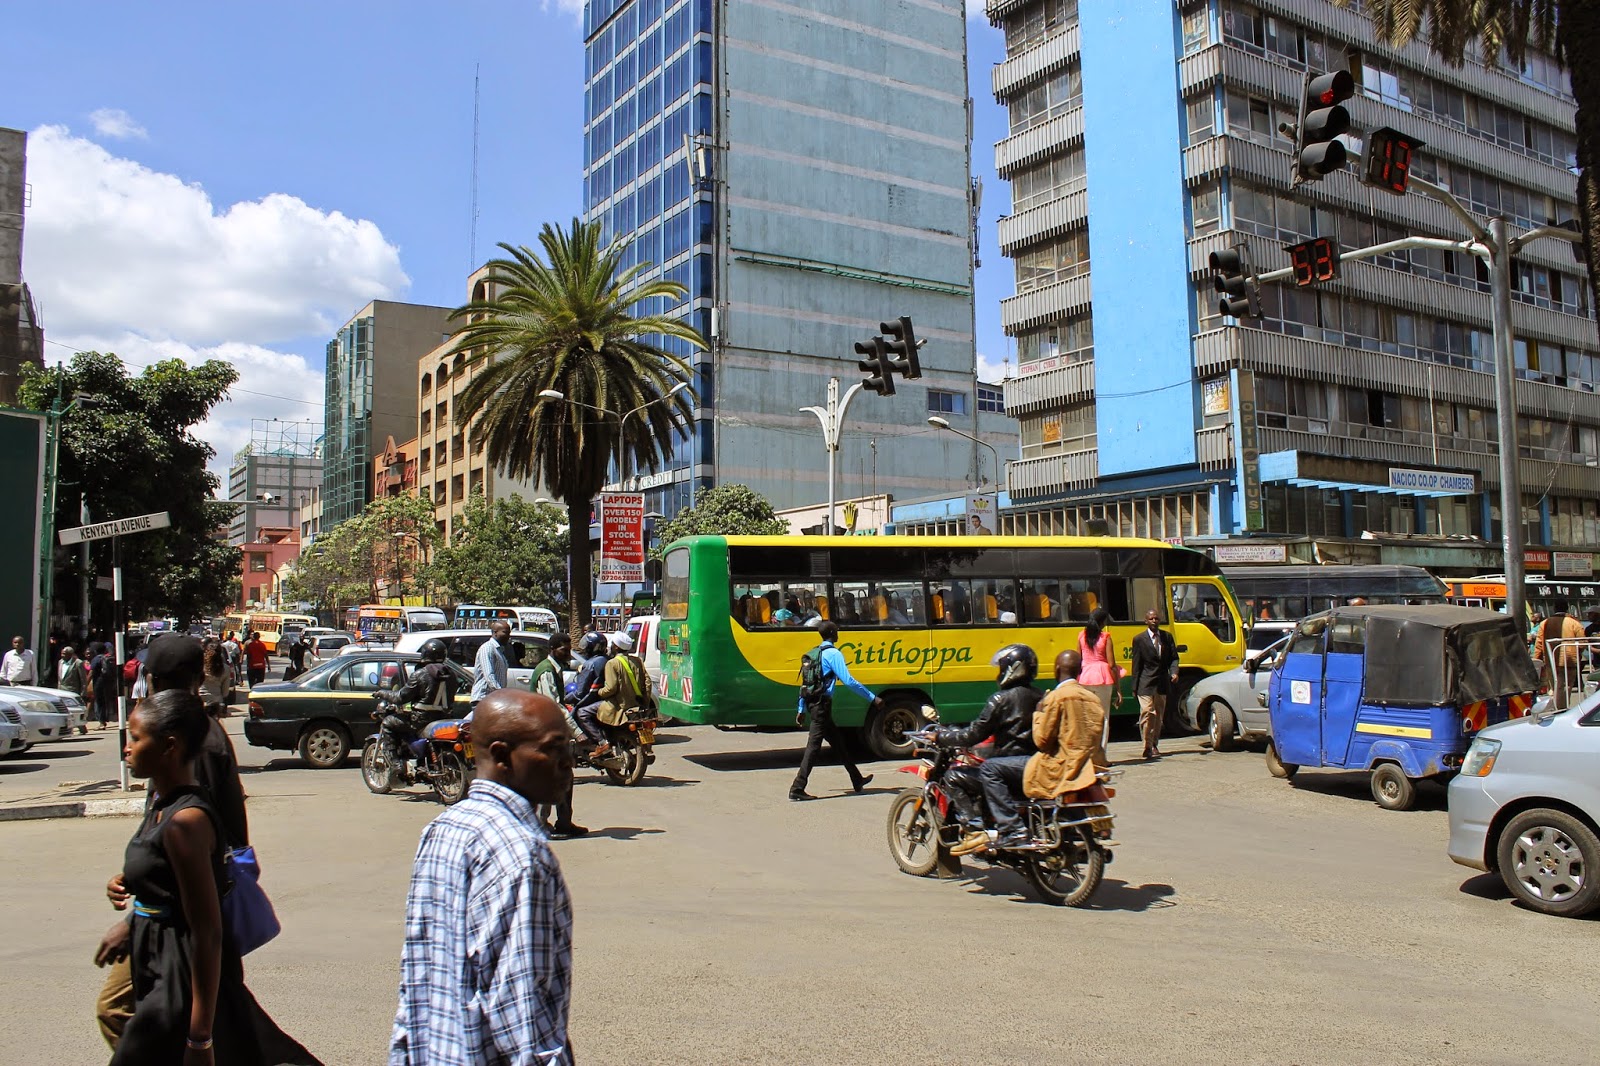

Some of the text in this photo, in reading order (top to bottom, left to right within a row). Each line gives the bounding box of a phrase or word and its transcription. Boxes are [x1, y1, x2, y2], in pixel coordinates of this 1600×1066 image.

[1384, 140, 1411, 192] 13
[1043, 359, 1056, 369] CYBER
[641, 472, 671, 488] CREDIT
[1246, 465, 1259, 510] PLUS
[1391, 472, 1417, 487] NACICO
[1440, 475, 1474, 491] CHAMBERS
[602, 495, 643, 504] LAPTOPS
[80, 517, 151, 540] KENYATTA AVENUE
[608, 531, 636, 539] STOCK
[838, 639, 973, 676] Citihoppa
